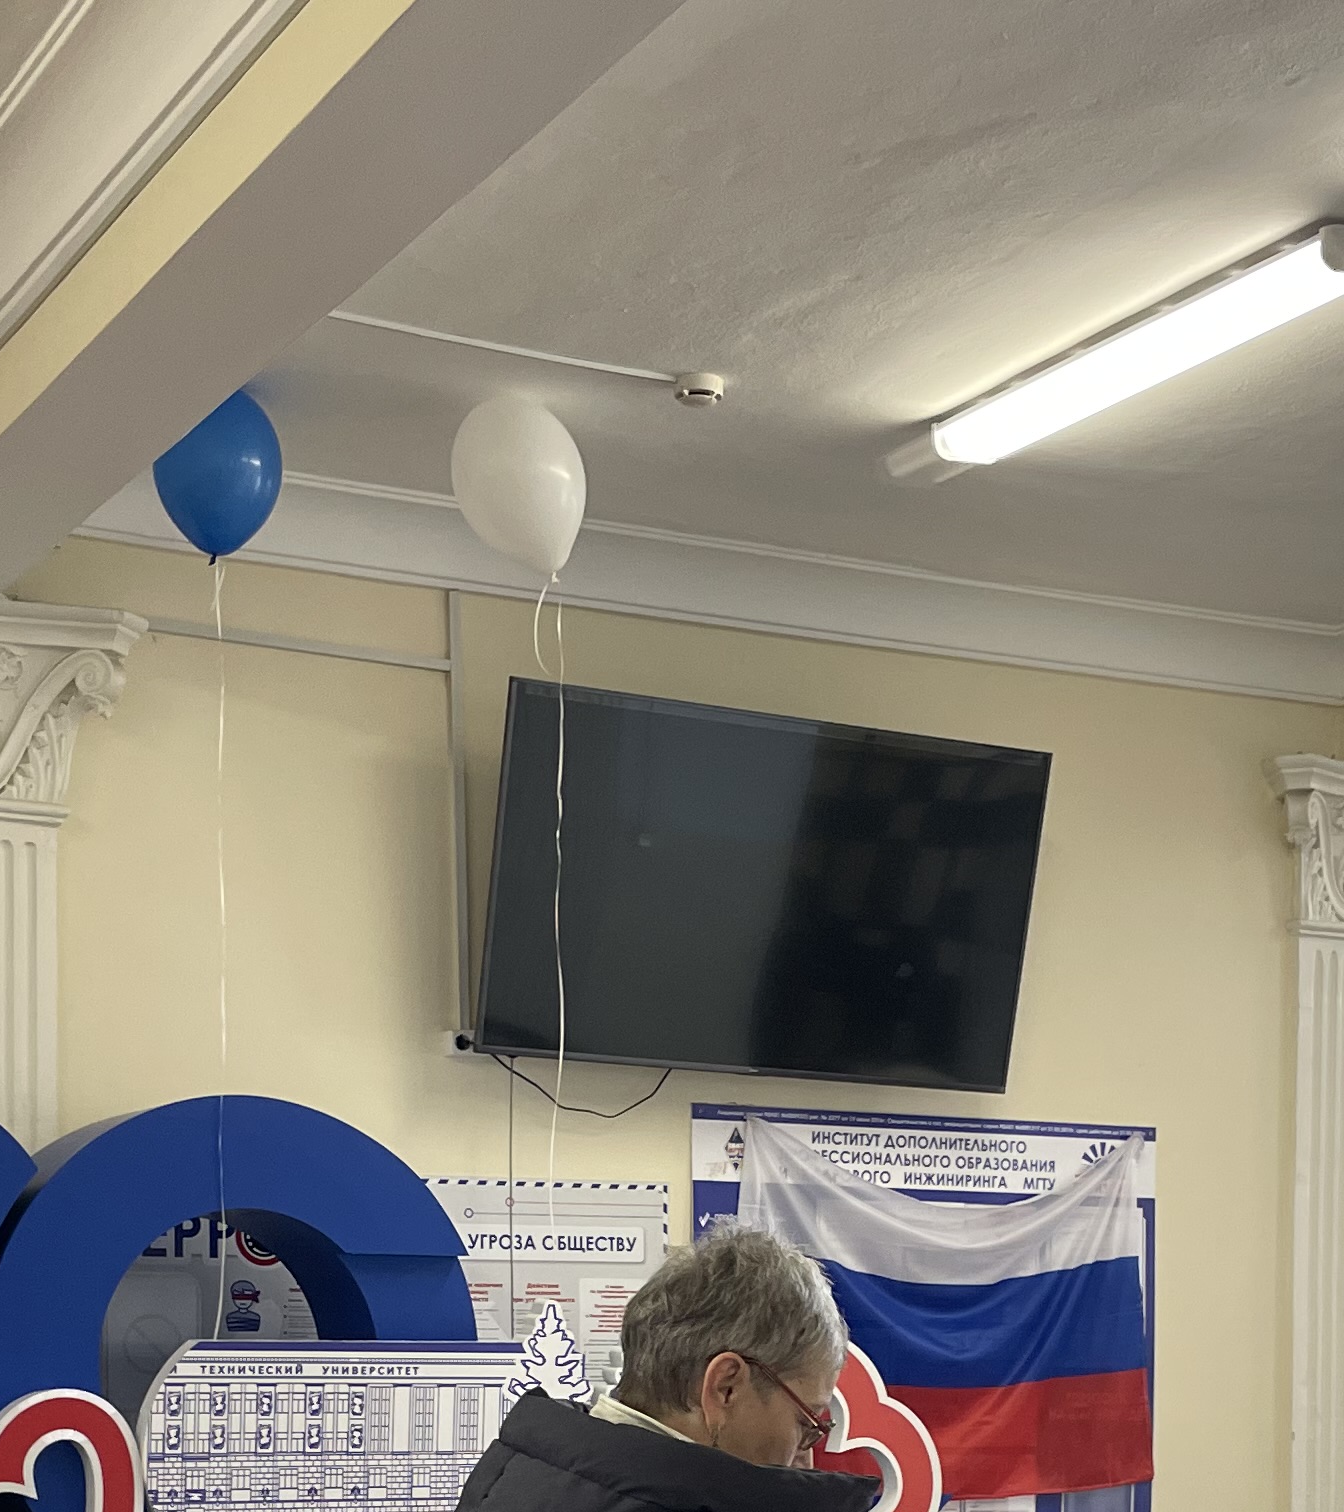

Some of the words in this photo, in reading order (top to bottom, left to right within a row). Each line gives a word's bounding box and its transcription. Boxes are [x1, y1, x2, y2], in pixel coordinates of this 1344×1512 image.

[811, 1130, 881, 1147] ИНСТИТУТ
[884, 1134, 1027, 1154] ДОПОЛНИТЕЛЬНОГО
[814, 1149, 951, 1168] ЕССИОНАЛЬНОГО
[955, 1156, 1056, 1173] ОБРАЗОВАНИЯ
[903, 1171, 1008, 1189] ИНЖИНИРИНГА
[1023, 1178, 1056, 1191] МГТУ
[467, 1233, 536, 1251] УГРОЗА
[200, 1363, 304, 1375] ТЕХНИЧЕСКИЙ
[322, 1366, 420, 1376] УНИВЕРСИТЕТ
